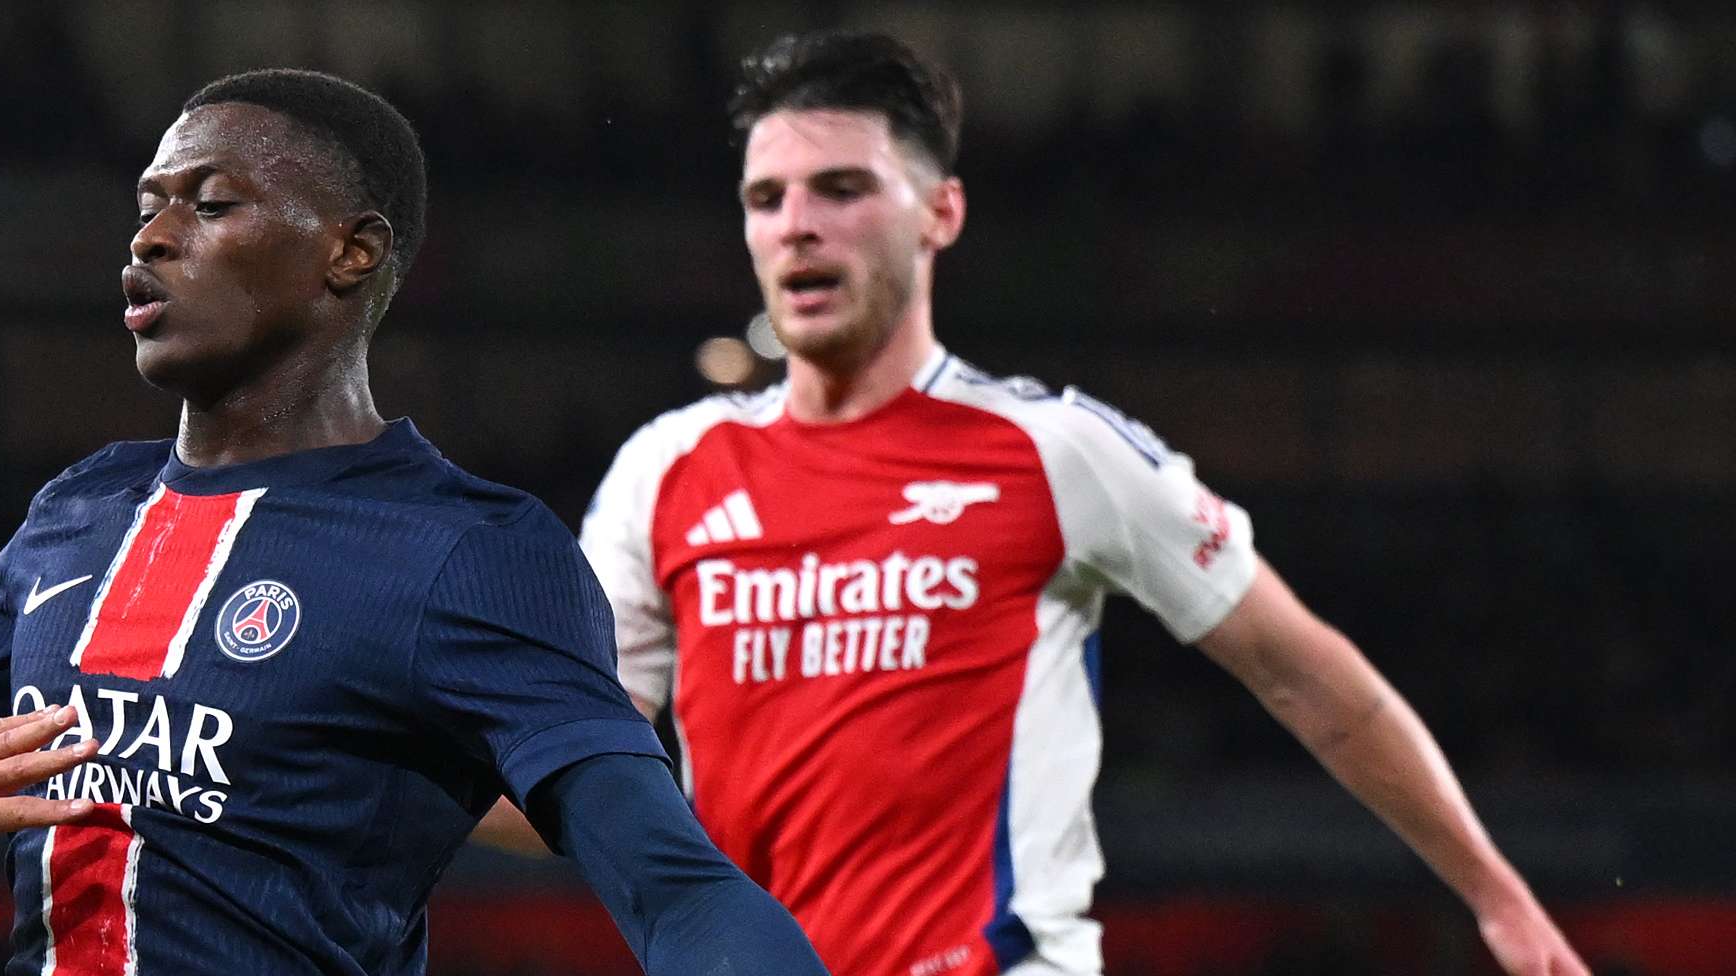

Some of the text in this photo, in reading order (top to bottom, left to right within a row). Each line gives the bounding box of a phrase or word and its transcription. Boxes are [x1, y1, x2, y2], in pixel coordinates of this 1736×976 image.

[244, 585, 294, 611] PARIS
[696, 551, 980, 626] Emirates
[732, 613, 932, 685] FLY BETTER
[47, 762, 228, 825] AIRWAYS
